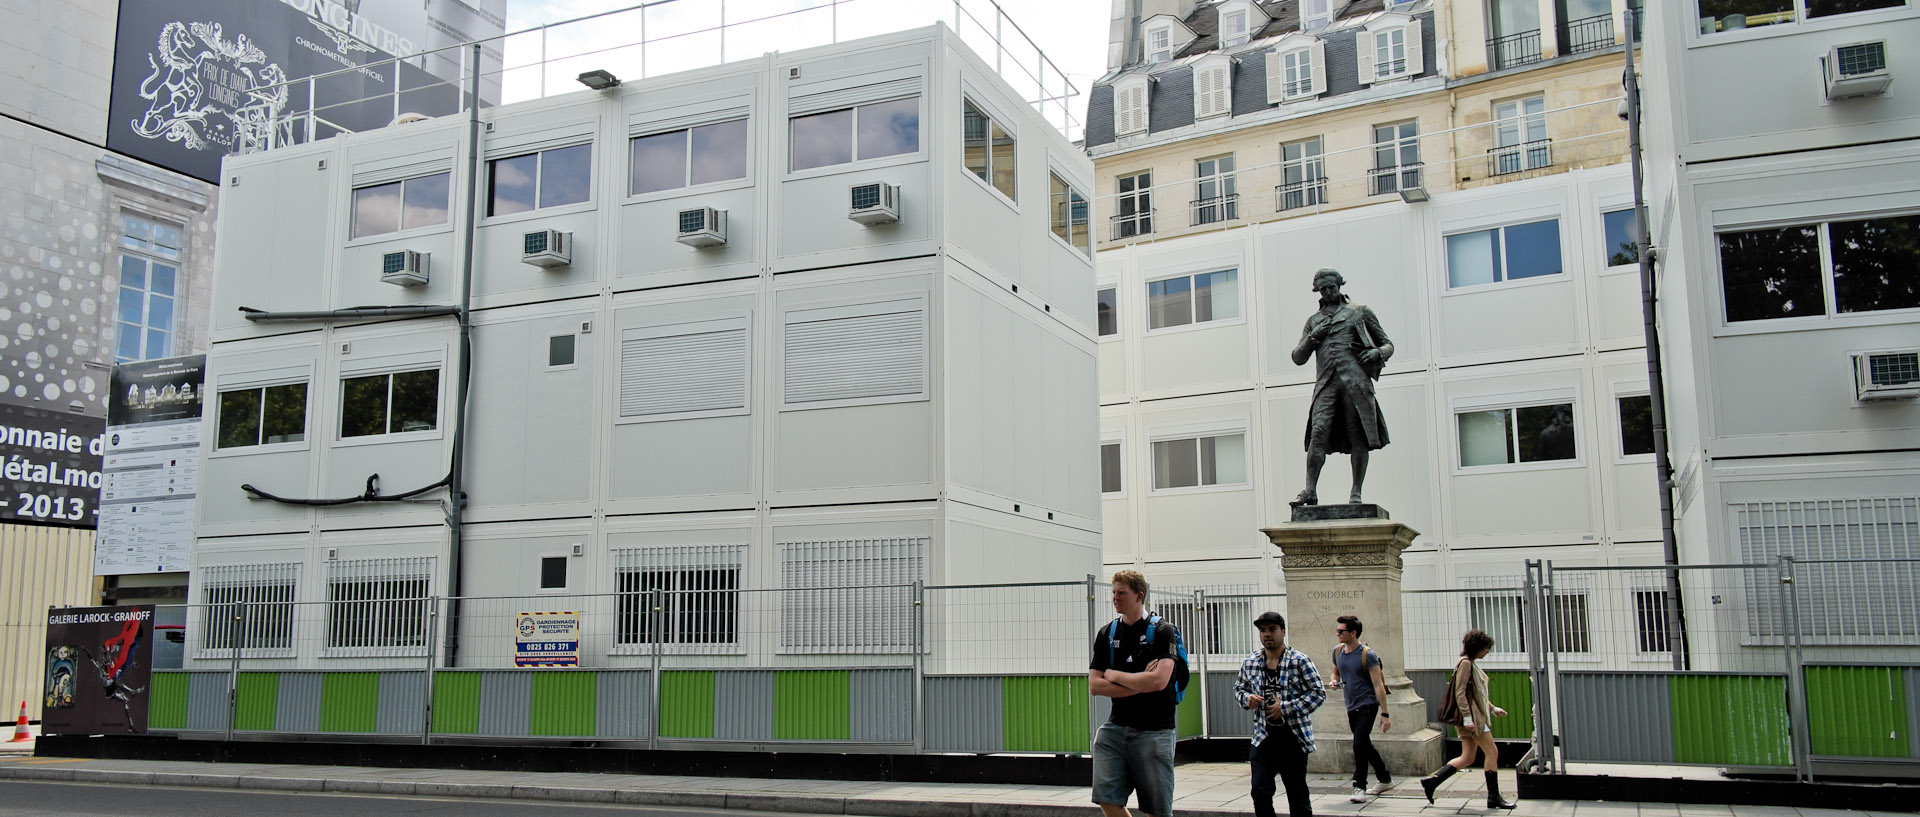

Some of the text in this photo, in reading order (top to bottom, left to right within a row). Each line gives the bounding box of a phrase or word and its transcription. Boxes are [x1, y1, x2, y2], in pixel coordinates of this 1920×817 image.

[277, 0, 413, 62] NGINES
[295, 36, 357, 69] CHRONOMETREUR
[203, 61, 249, 94] PRIX DE DIANE
[208, 82, 239, 108] LONGINES
[205, 132, 232, 147] GALOP
[0, 454, 102, 489] étaLmo
[17, 492, 85, 521] 2013
[1307, 591, 1365, 599] CONDORCET
[49, 614, 79, 625] GALERIE
[558, 642, 569, 650] 371
